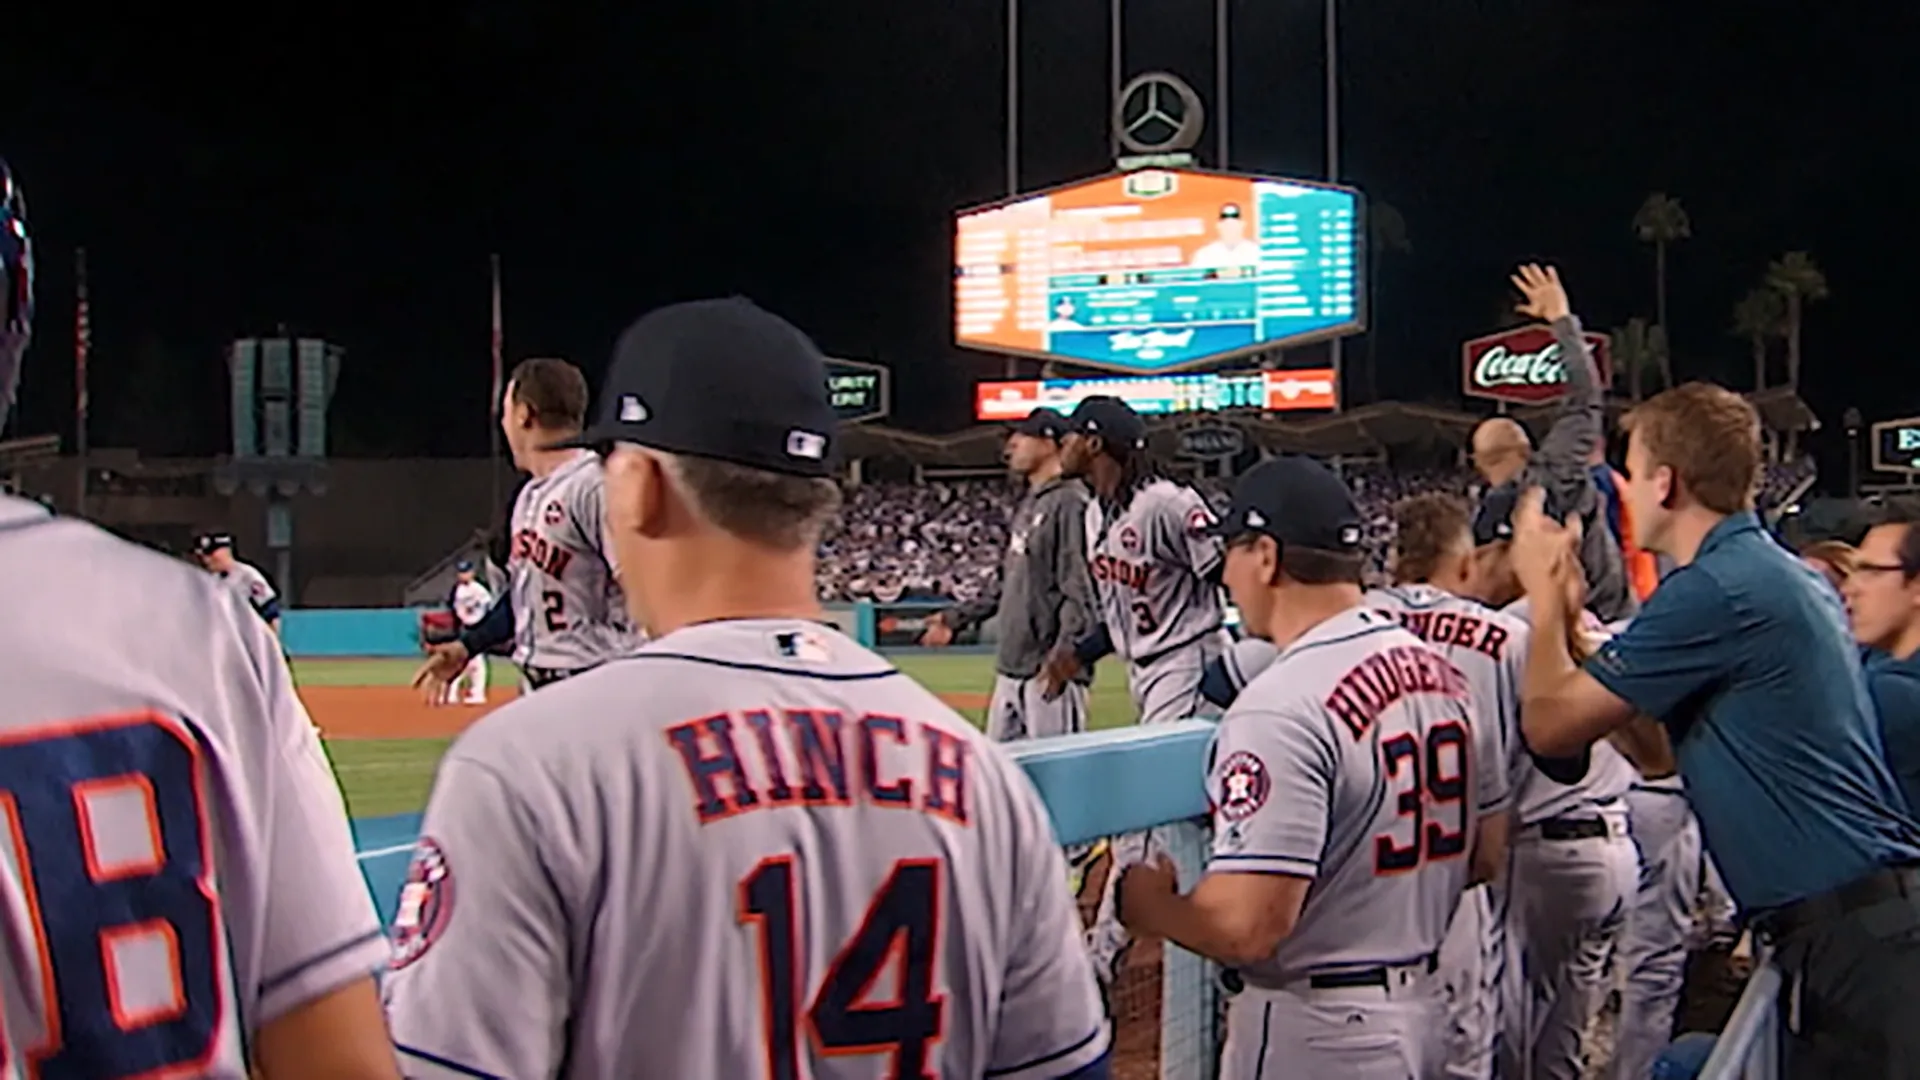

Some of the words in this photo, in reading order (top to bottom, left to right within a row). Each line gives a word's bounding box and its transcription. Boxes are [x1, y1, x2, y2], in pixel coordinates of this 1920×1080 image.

[541, 589, 568, 632] 2
[1131, 601, 1158, 636] 3
[665, 708, 973, 826] HINCH
[1373, 720, 1469, 877] 39
[736, 853, 950, 1080] 14
